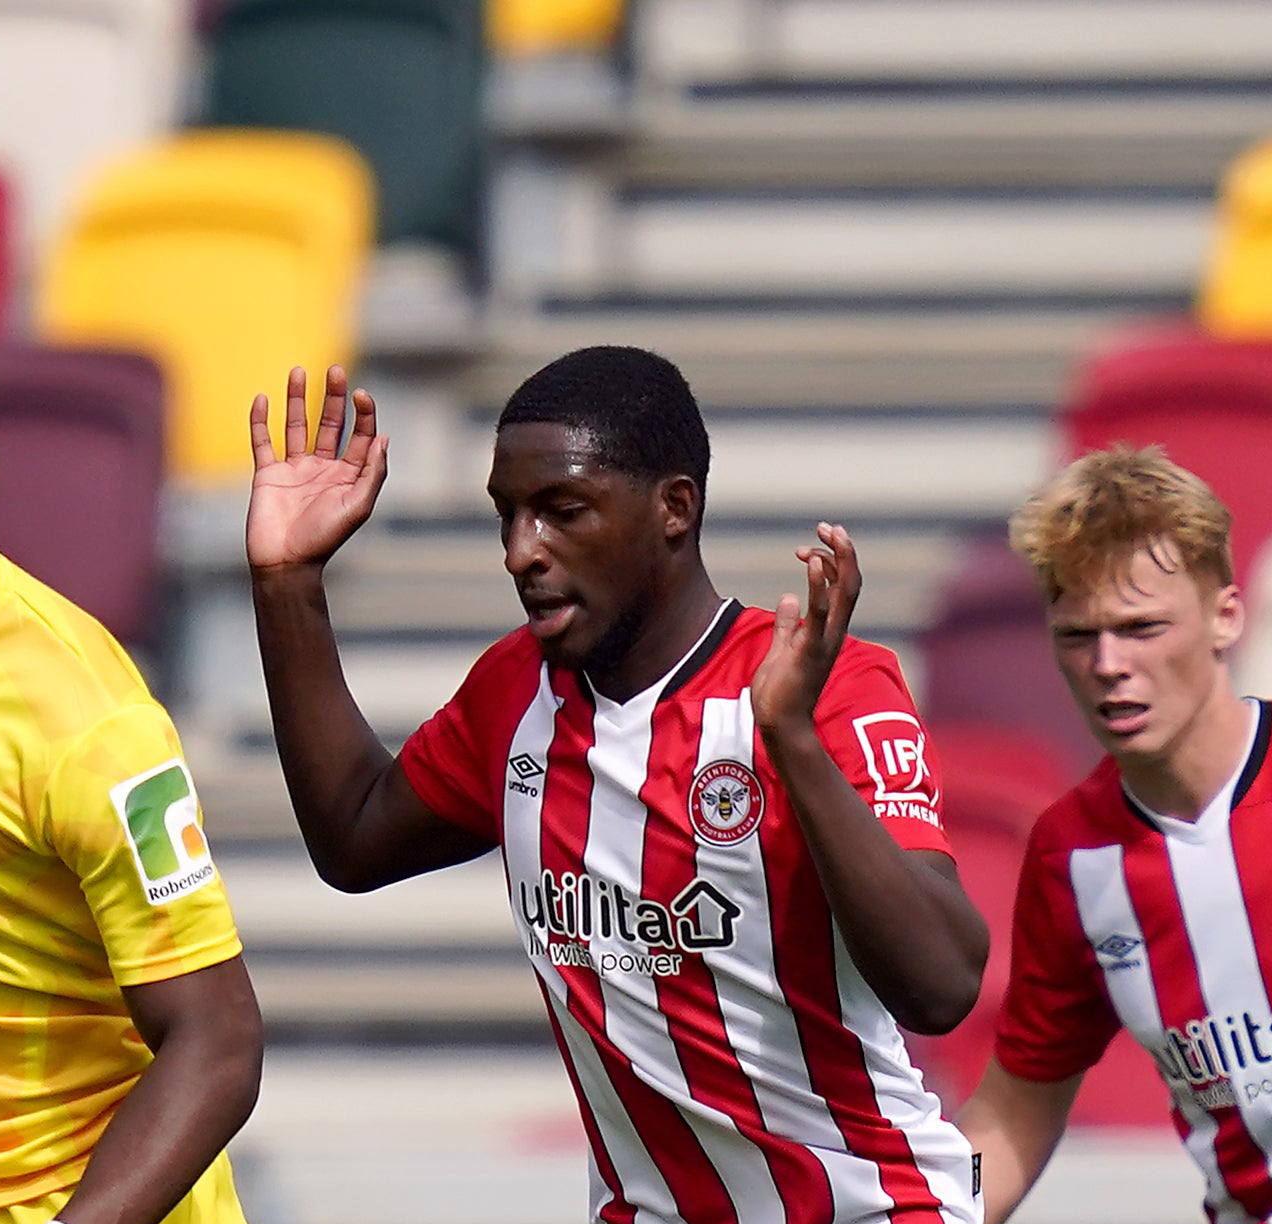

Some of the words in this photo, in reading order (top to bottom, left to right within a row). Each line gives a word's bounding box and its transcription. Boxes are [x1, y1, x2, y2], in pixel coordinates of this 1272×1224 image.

[697, 766, 750, 789] BRENTFORD
[873, 801, 944, 831] PAYMEN
[147, 863, 214, 901] Robertsons
[520, 872, 674, 947] utilita
[600, 952, 682, 977] power
